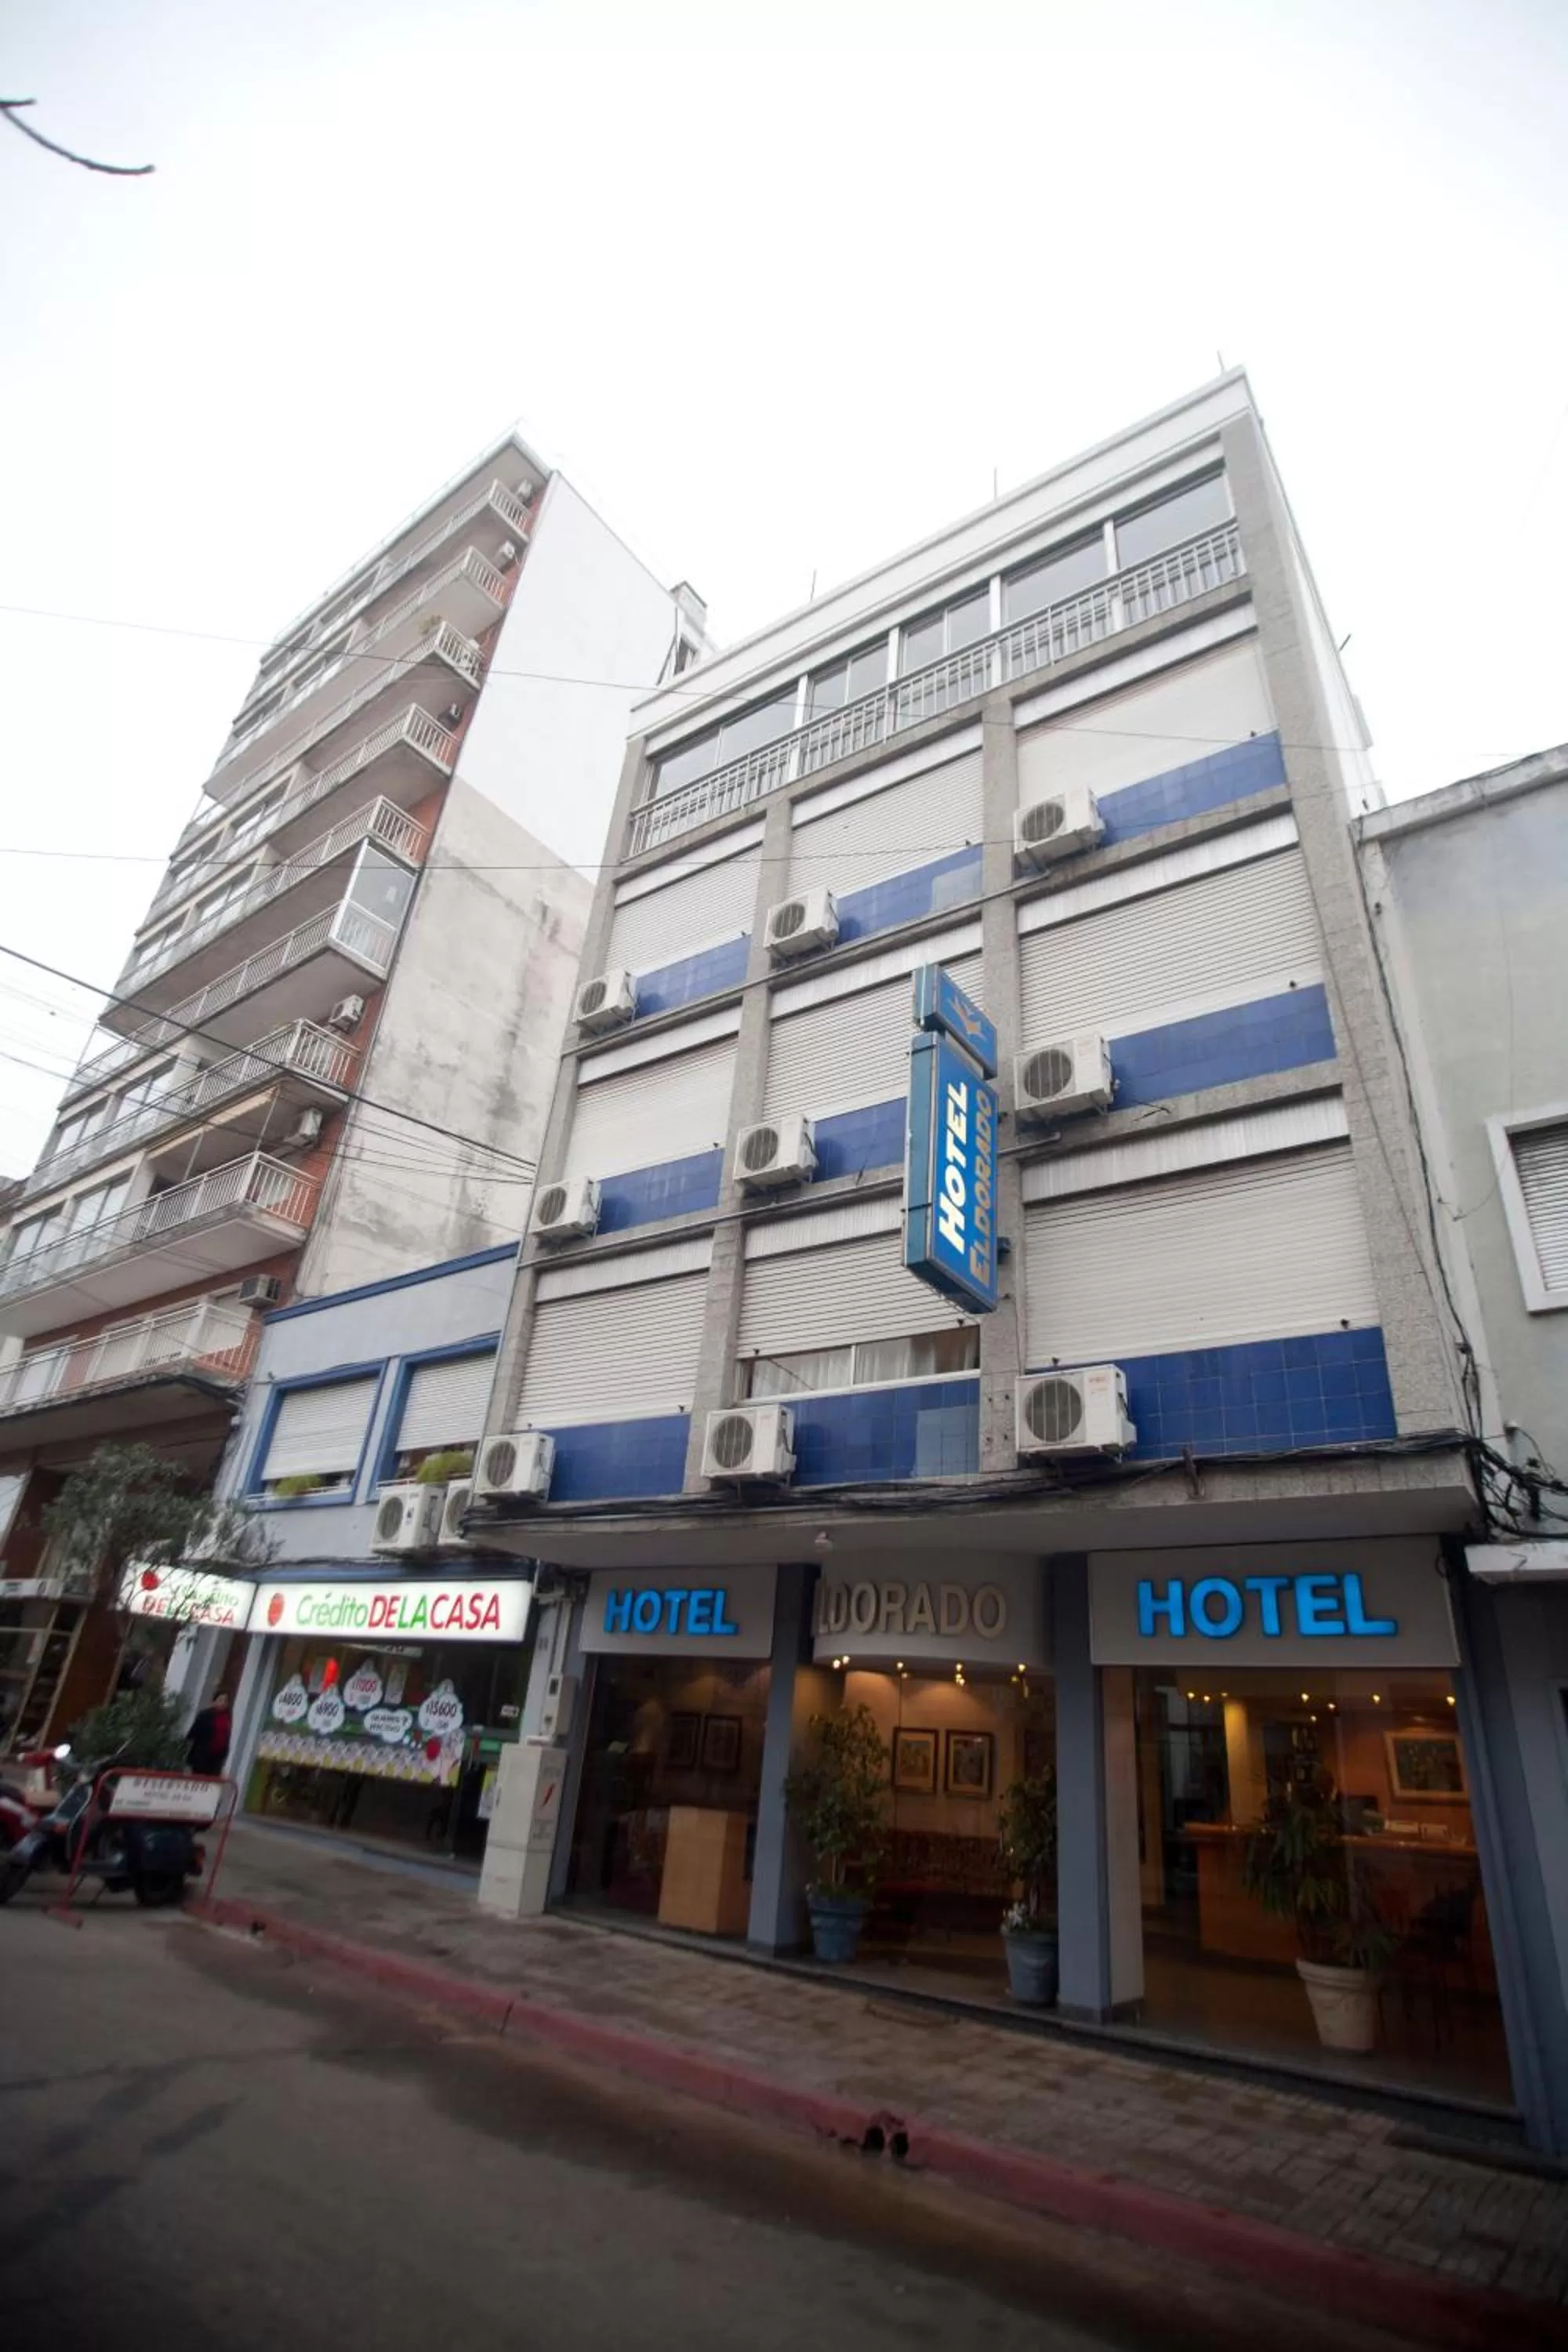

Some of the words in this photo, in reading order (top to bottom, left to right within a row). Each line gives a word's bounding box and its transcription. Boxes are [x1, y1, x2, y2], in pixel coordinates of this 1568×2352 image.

[938, 1081, 967, 1255] HOTEL
[603, 1588, 739, 1635] HOTEL
[1138, 1573, 1398, 1638] HOTEL
